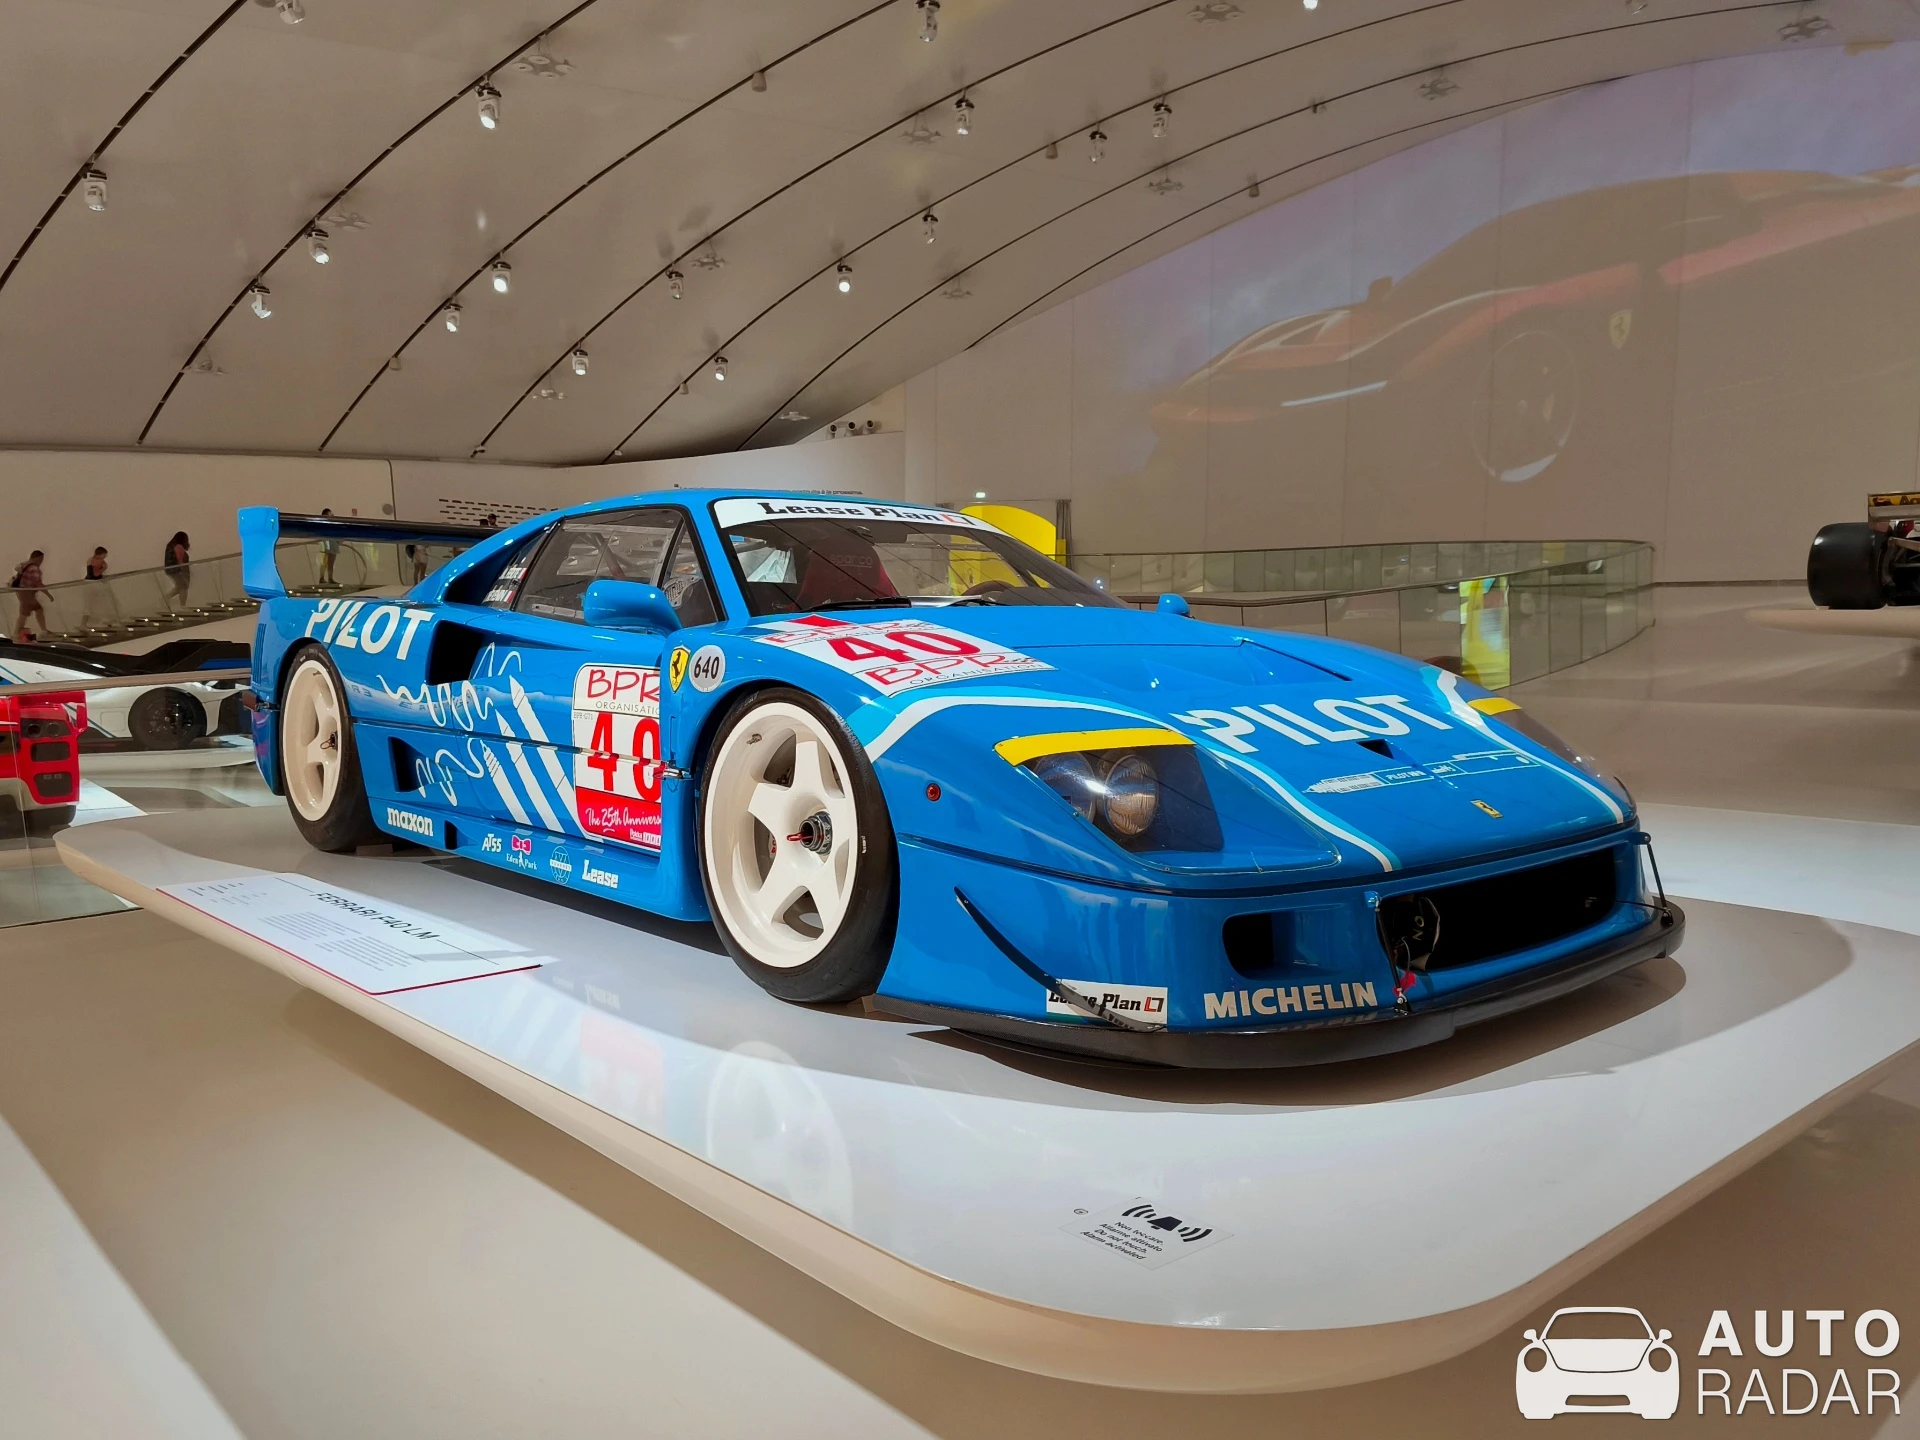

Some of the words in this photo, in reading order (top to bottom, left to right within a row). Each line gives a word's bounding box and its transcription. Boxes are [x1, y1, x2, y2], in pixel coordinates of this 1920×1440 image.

[757, 502, 865, 516] Lease
[866, 506, 942, 522] Plan
[304, 598, 436, 660] PILOT
[827, 631, 981, 662] 40
[694, 655, 720, 679] 640
[865, 654, 1033, 685] BPR
[909, 663, 1043, 685] ORGANISATION
[587, 669, 660, 703] BPR
[1169, 694, 1454, 753] PILOT
[587, 711, 662, 802] 40
[387, 807, 434, 837] maxon
[585, 807, 601, 827] The
[601, 806, 622, 827] 25th
[506, 853, 519, 865] Eden
[524, 859, 538, 870] Park
[581, 859, 619, 889] Lease
[309, 892, 382, 917] FERRARI
[370, 915, 412, 928] F40
[402, 928, 440, 939] LM
[1102, 993, 1142, 1011] Plan
[1203, 981, 1378, 1020] MICHELIN
[1114, 1222, 1132, 1231] Non
[1080, 1231, 1106, 1242] Alarm
[1105, 1242, 1147, 1259] activated
[1131, 1237, 1162, 1251] attivato
